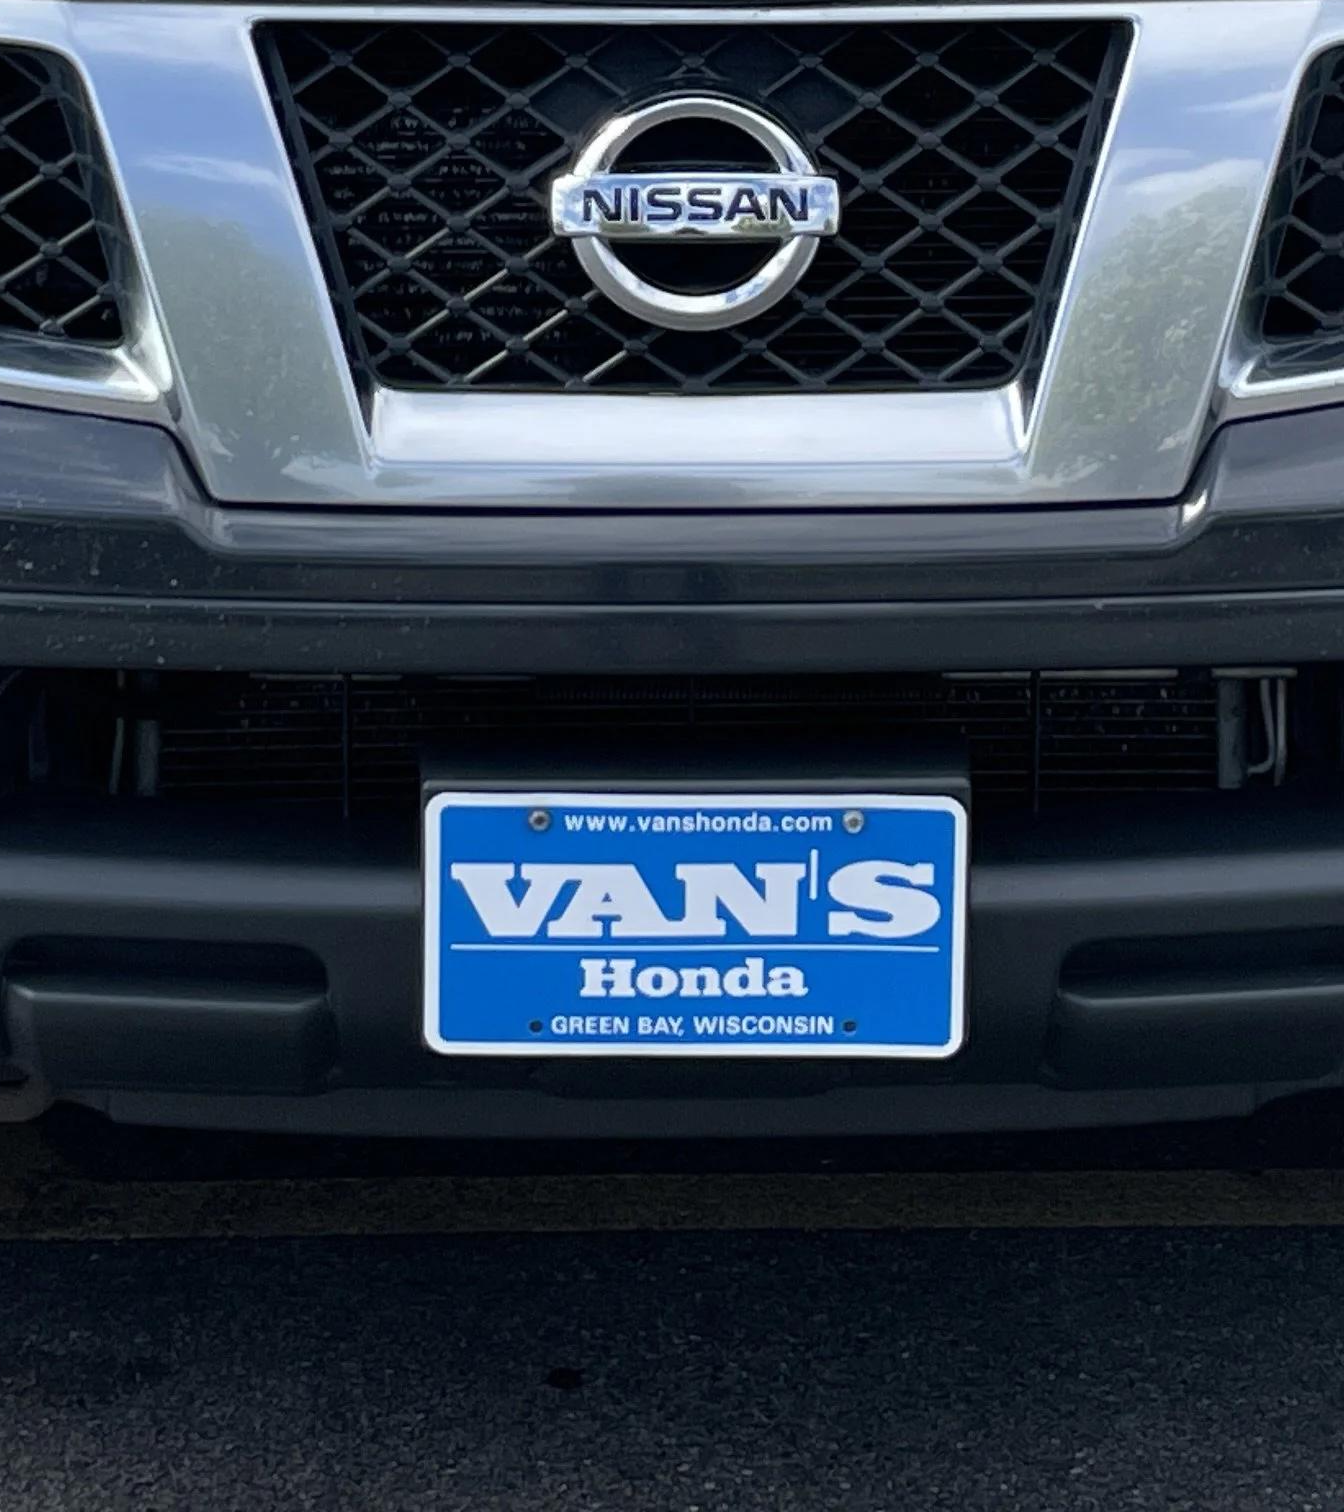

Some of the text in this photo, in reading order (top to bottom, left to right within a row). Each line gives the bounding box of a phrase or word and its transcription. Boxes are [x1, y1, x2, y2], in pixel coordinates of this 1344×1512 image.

[582, 187, 809, 223] NISSAN
[564, 812, 833, 833] www.vanshonda.com
[450, 849, 941, 938] VAN'S
[579, 958, 809, 998] Honda
[550, 1016, 834, 1038] GREEN BAY, WISCONSIN
